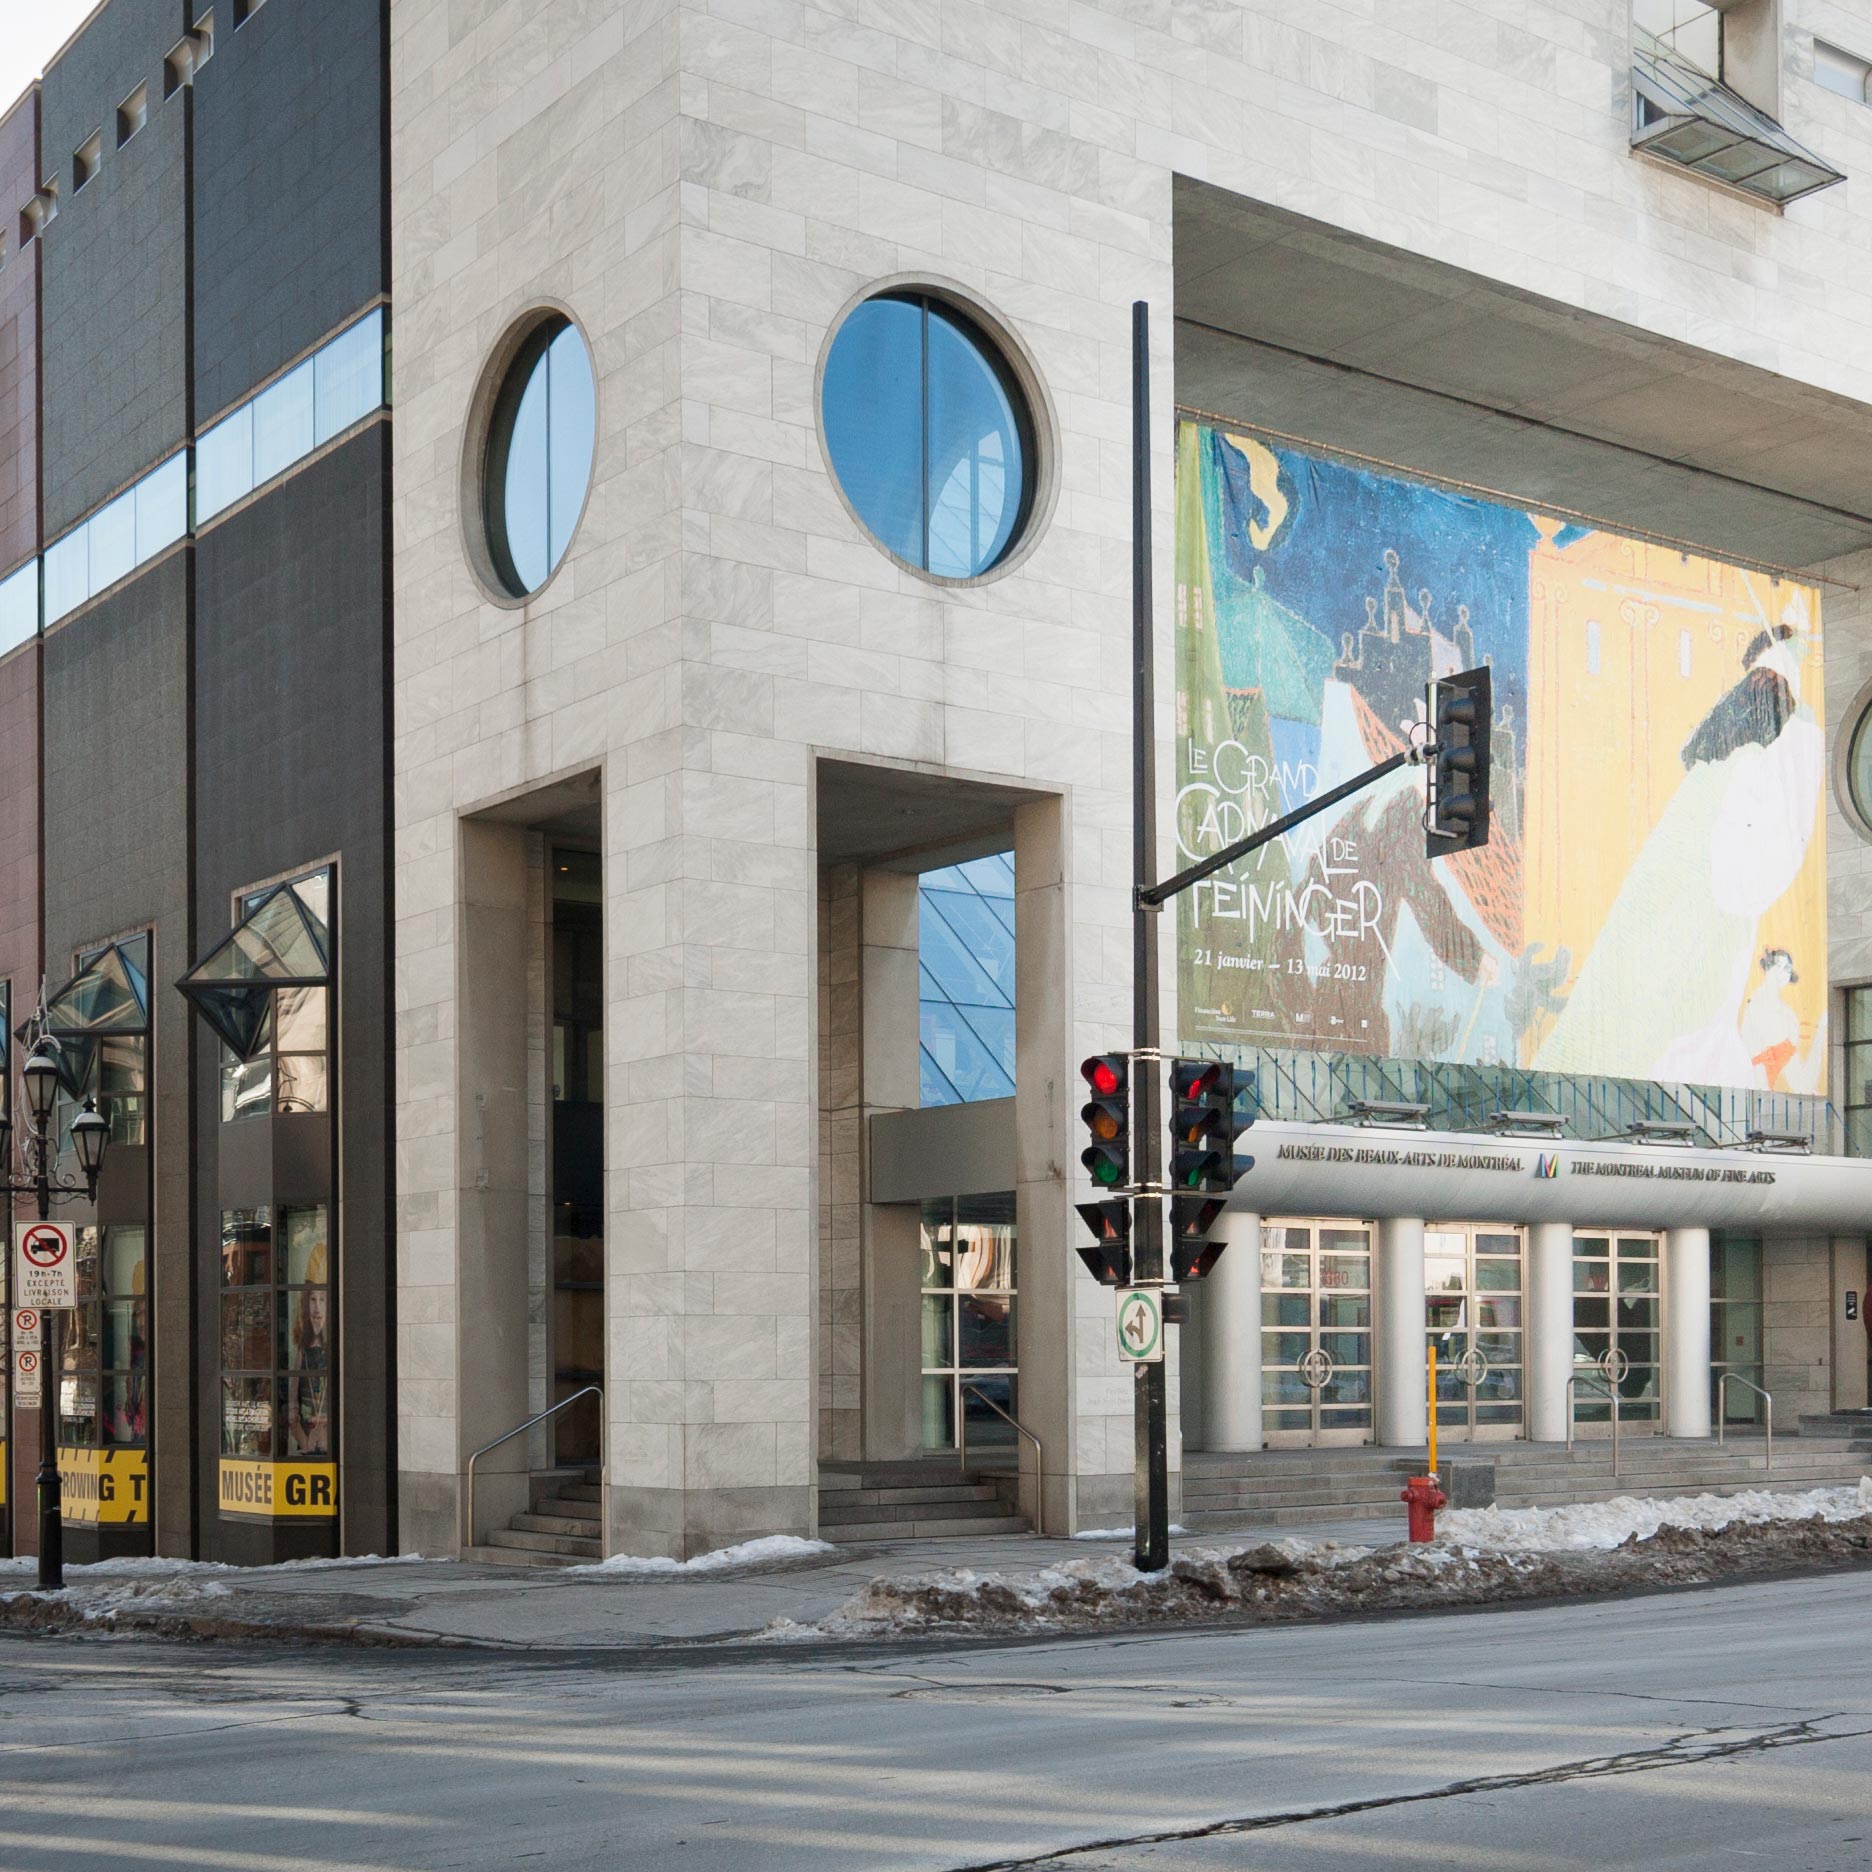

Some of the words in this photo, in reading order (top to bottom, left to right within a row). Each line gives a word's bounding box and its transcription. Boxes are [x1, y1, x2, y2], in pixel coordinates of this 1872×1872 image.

[1189, 738, 1208, 775] LE
[1213, 740, 1321, 812] GRAND
[1331, 837, 1359, 861] DE
[1194, 949, 1212, 965] 21
[1217, 950, 1264, 971] janvier
[1287, 958, 1304, 975] 13
[1307, 962, 1331, 978] mai
[1334, 964, 1367, 981] 2012
[1278, 1142, 1325, 1161] MUSÉE
[1327, 1146, 1354, 1162] DES
[1355, 1148, 1436, 1166] BEAUX-ARTS
[1437, 1153, 1457, 1169] DE
[1458, 1154, 1525, 1172] MONTRÉAL
[1571, 1161, 1595, 1175] THE
[1595, 1162, 1657, 1178] MONTREAL
[1706, 1168, 1721, 1181] OF
[1721, 1169, 1747, 1183] FINE
[1747, 1171, 1776, 1184] ARTS
[24, 1289, 70, 1297] LIVRAISON
[27, 1277, 65, 1287] EXCEPTÉ
[31, 1298, 62, 1306] LOCALE
[59, 1469, 115, 1502] ROWING
[222, 1465, 272, 1505] MUSÉE
